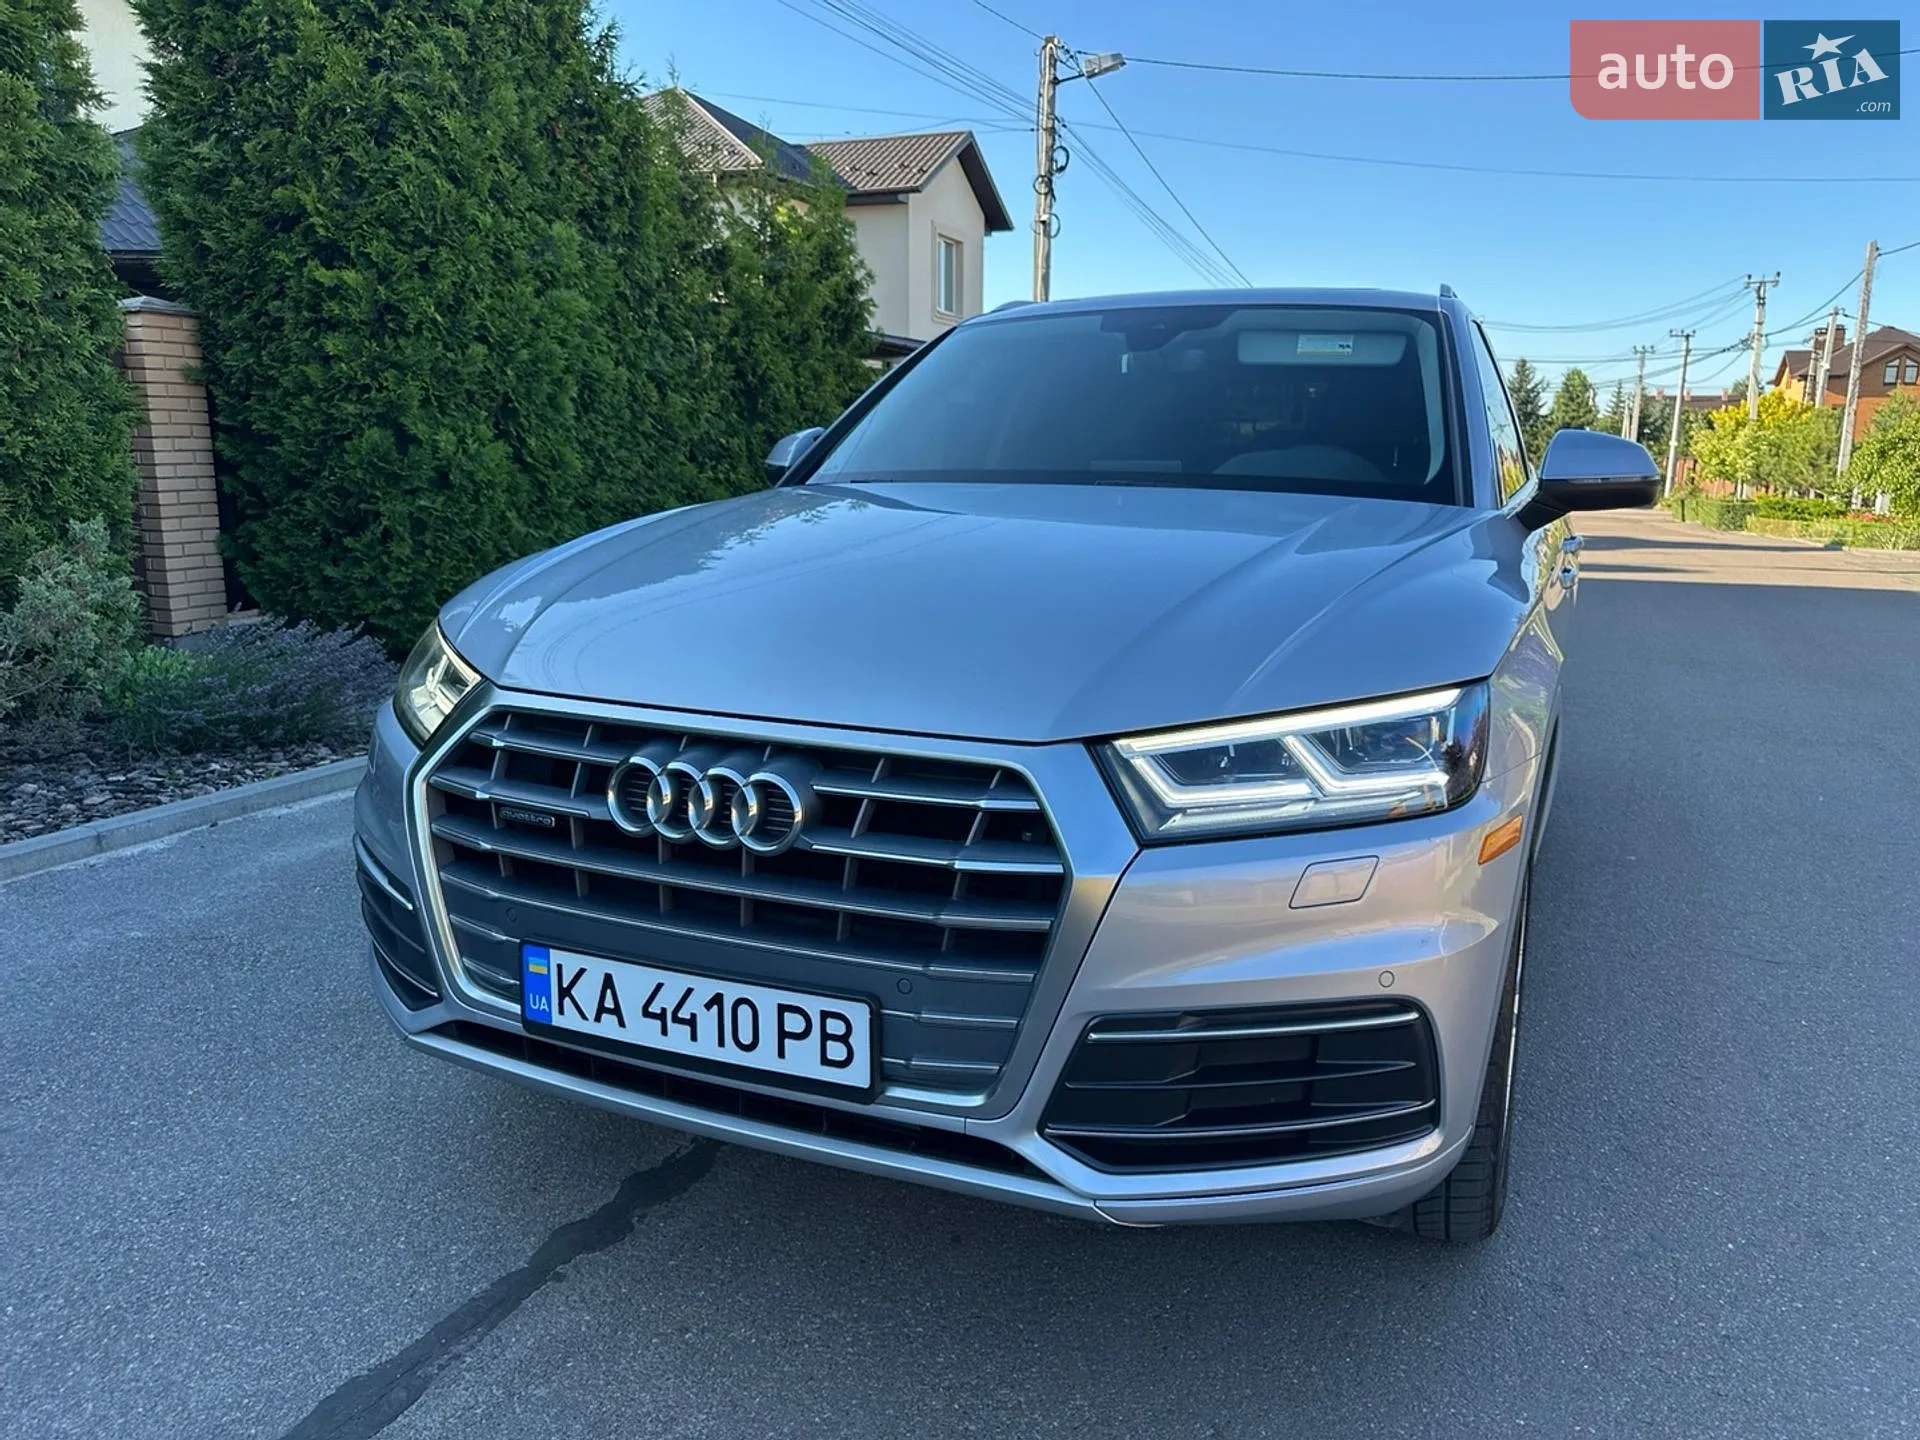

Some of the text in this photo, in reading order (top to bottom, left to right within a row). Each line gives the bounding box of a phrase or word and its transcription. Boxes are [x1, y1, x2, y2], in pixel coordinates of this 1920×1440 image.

[529, 993, 549, 1012] UA
[556, 963, 855, 1069] KA 4410 PB
